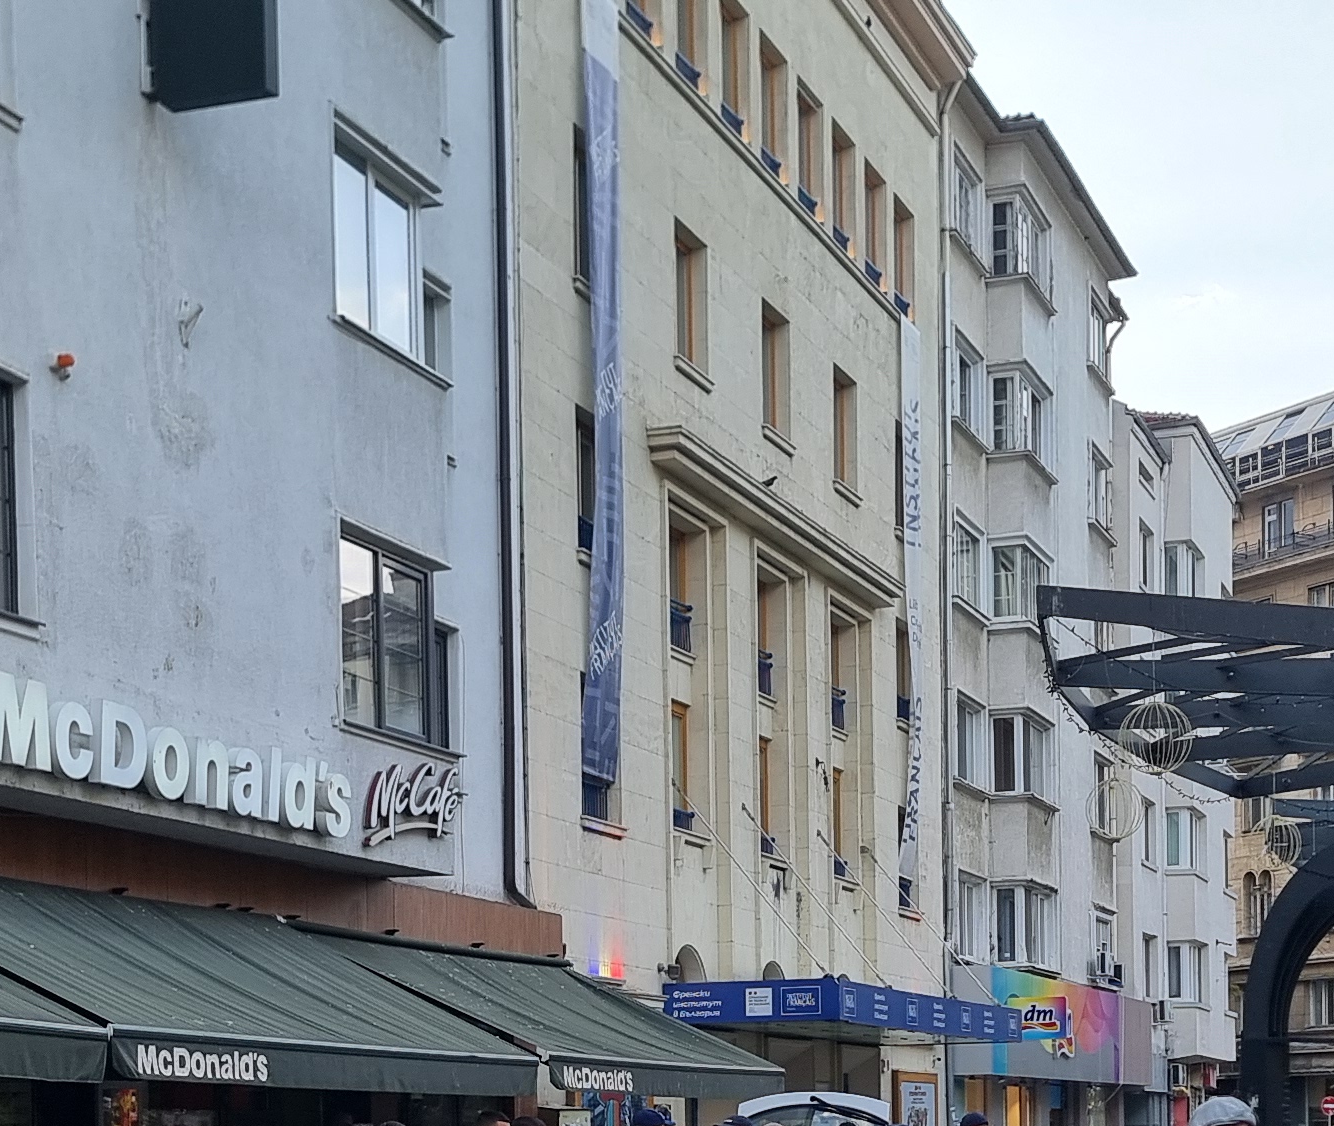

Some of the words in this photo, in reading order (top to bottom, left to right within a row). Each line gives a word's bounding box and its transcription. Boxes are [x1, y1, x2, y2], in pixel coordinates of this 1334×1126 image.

[365, 762, 459, 839] McCafé
[1024, 1005, 1054, 1022] dm
[137, 1043, 268, 1082] McDonald's
[563, 1065, 634, 1092] McDonald's
